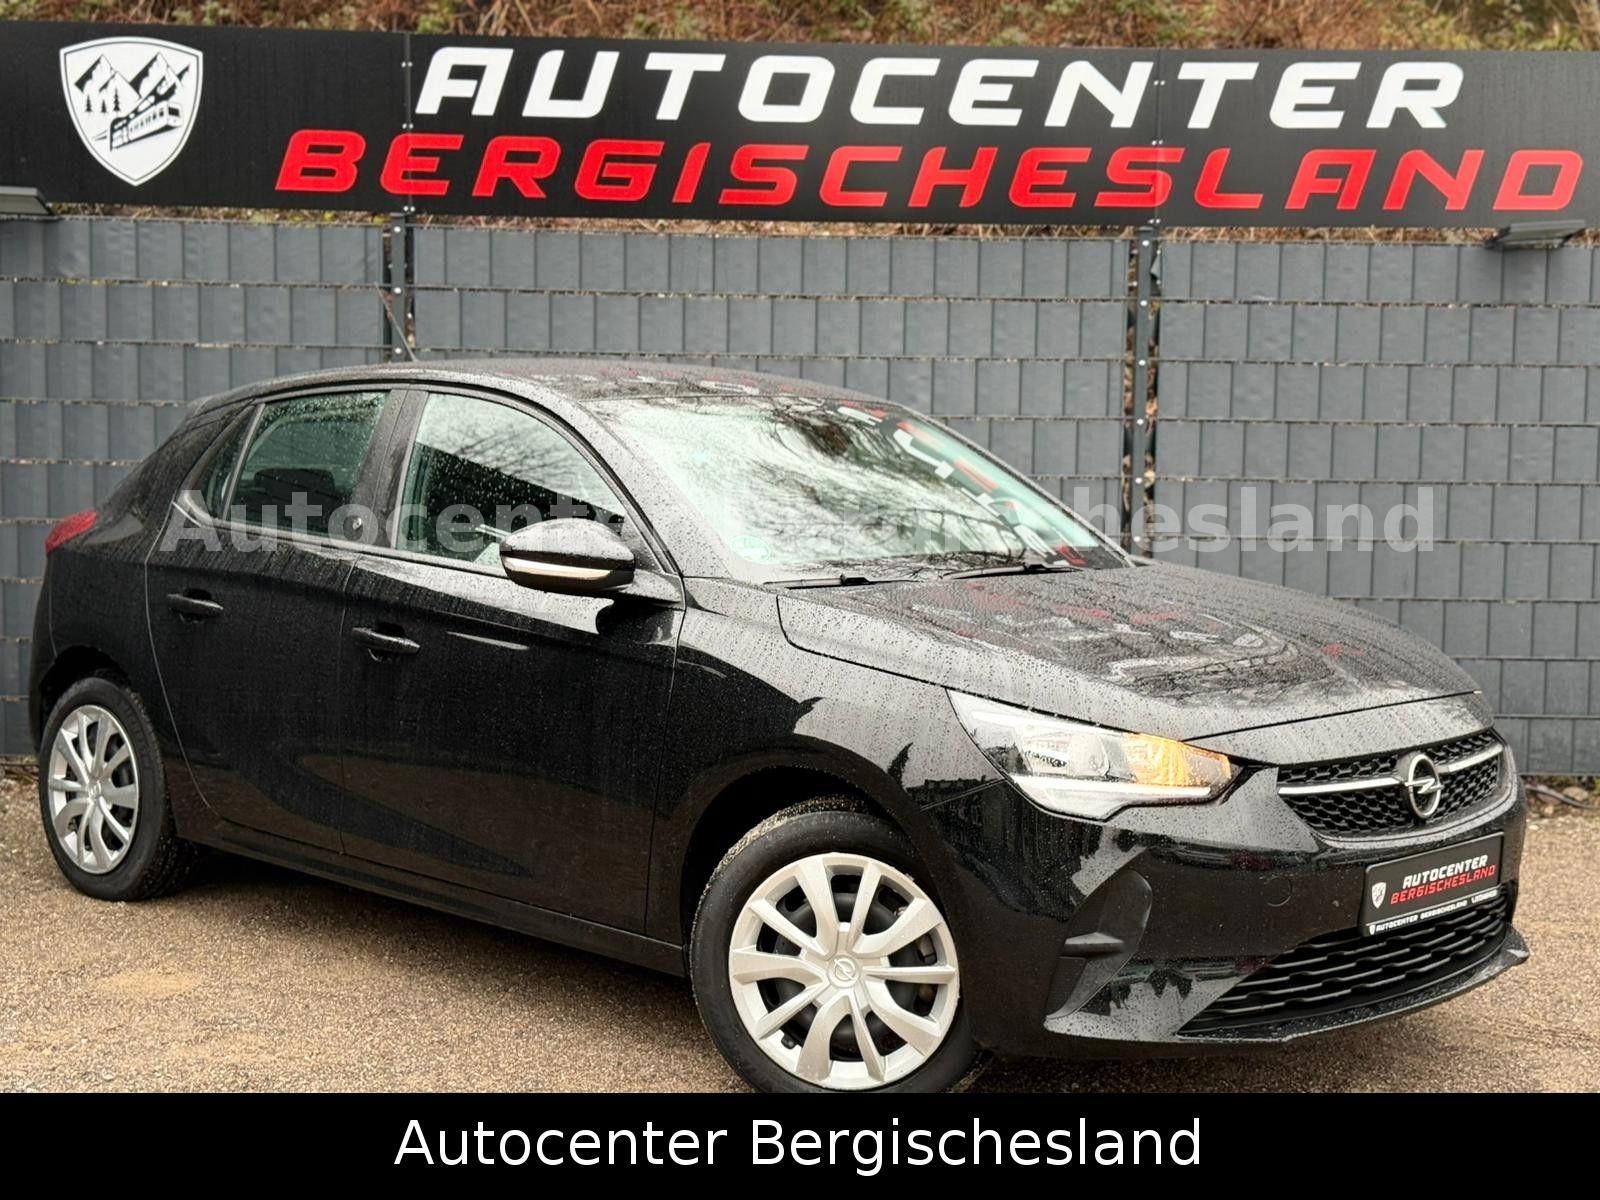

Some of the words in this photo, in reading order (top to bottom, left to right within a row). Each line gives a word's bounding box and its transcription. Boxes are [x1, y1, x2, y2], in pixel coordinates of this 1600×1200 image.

[415, 47, 1465, 129] AUTOCENTER
[275, 130, 1582, 211] BERGISCHESLAND
[1390, 865, 1496, 905] BERGISCHESLAND
[1402, 855, 1488, 889] AUTOCENTER
[1375, 914, 1418, 932] AUTOCENTER
